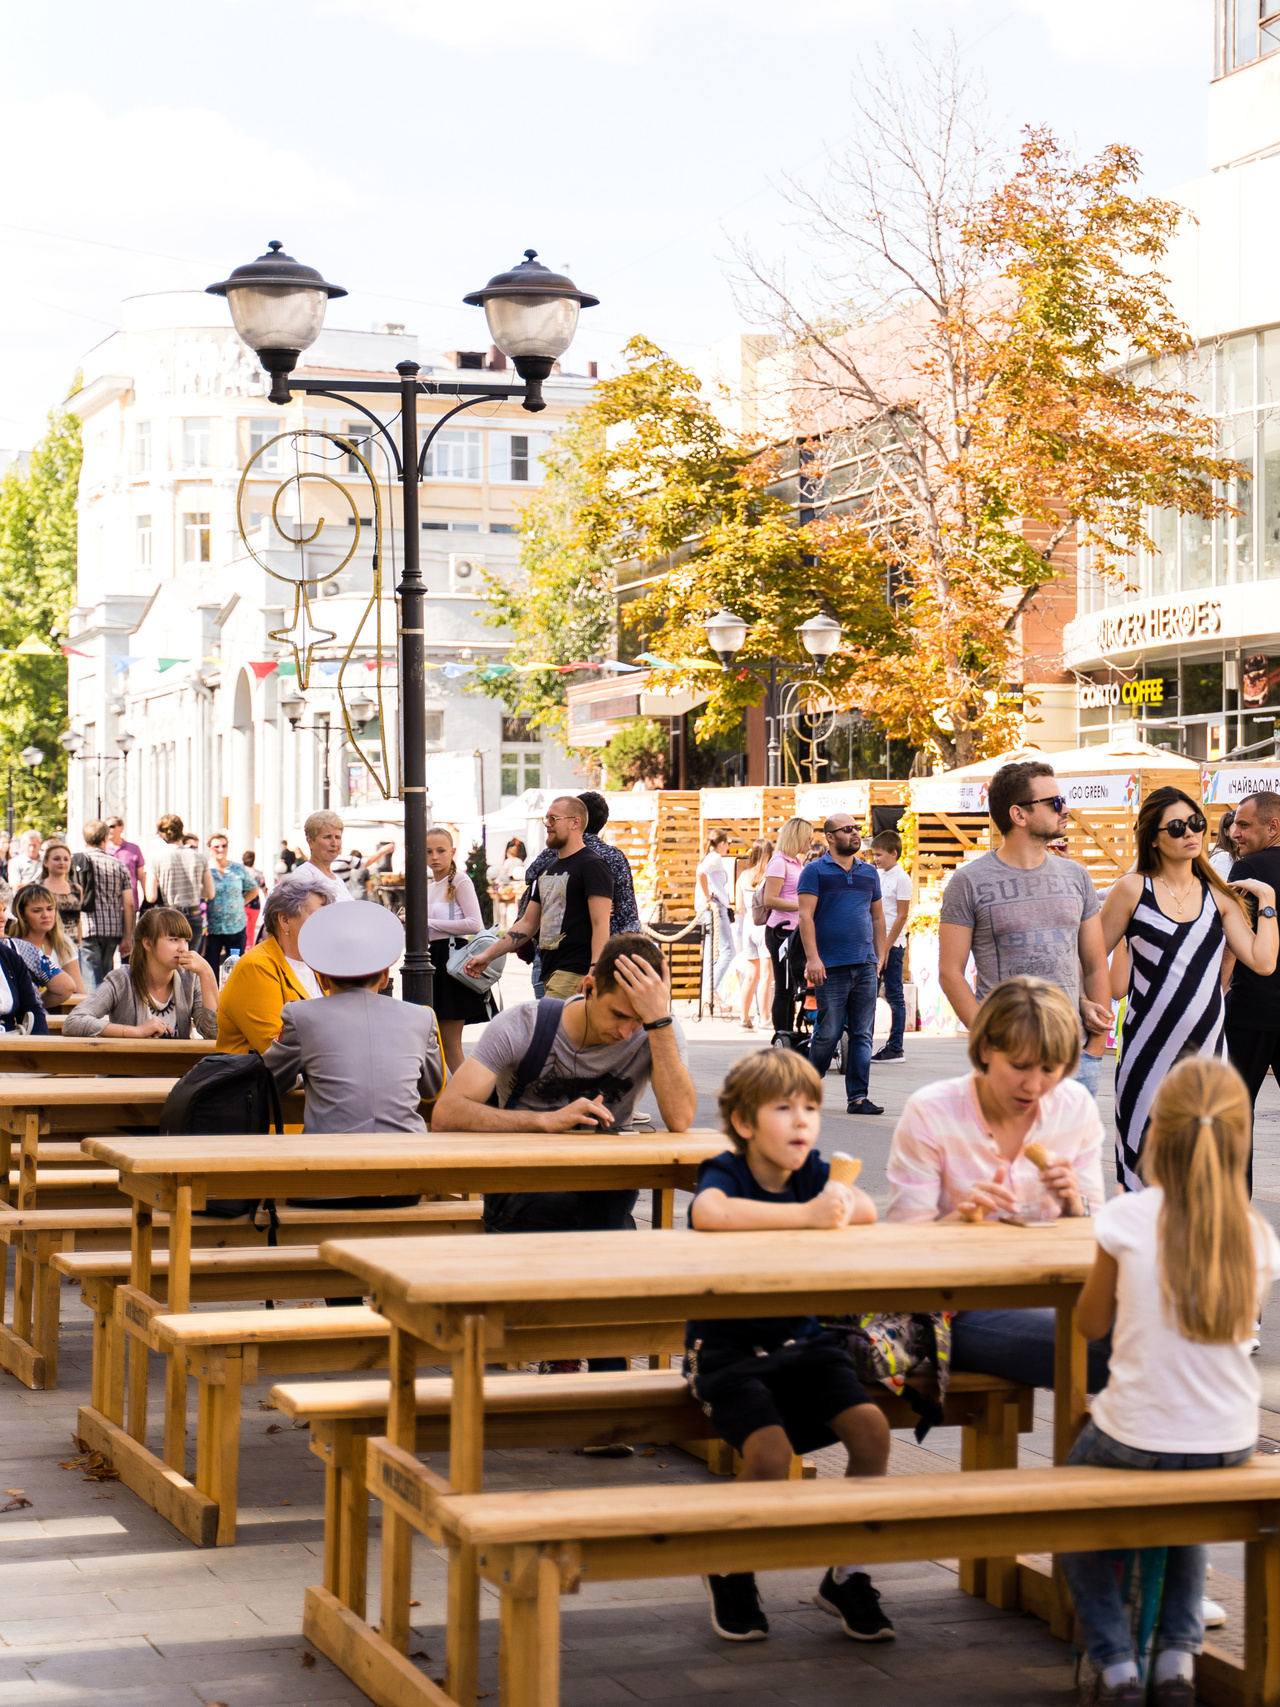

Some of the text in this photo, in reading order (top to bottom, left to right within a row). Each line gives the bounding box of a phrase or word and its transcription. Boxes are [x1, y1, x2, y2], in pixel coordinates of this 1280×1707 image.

[1151, 600, 1221, 640] HEROES
[1122, 678, 1164, 704] COFFEE
[1068, 785, 1109, 799] «GO GREEN»
[976, 873, 1081, 904] SUPER
